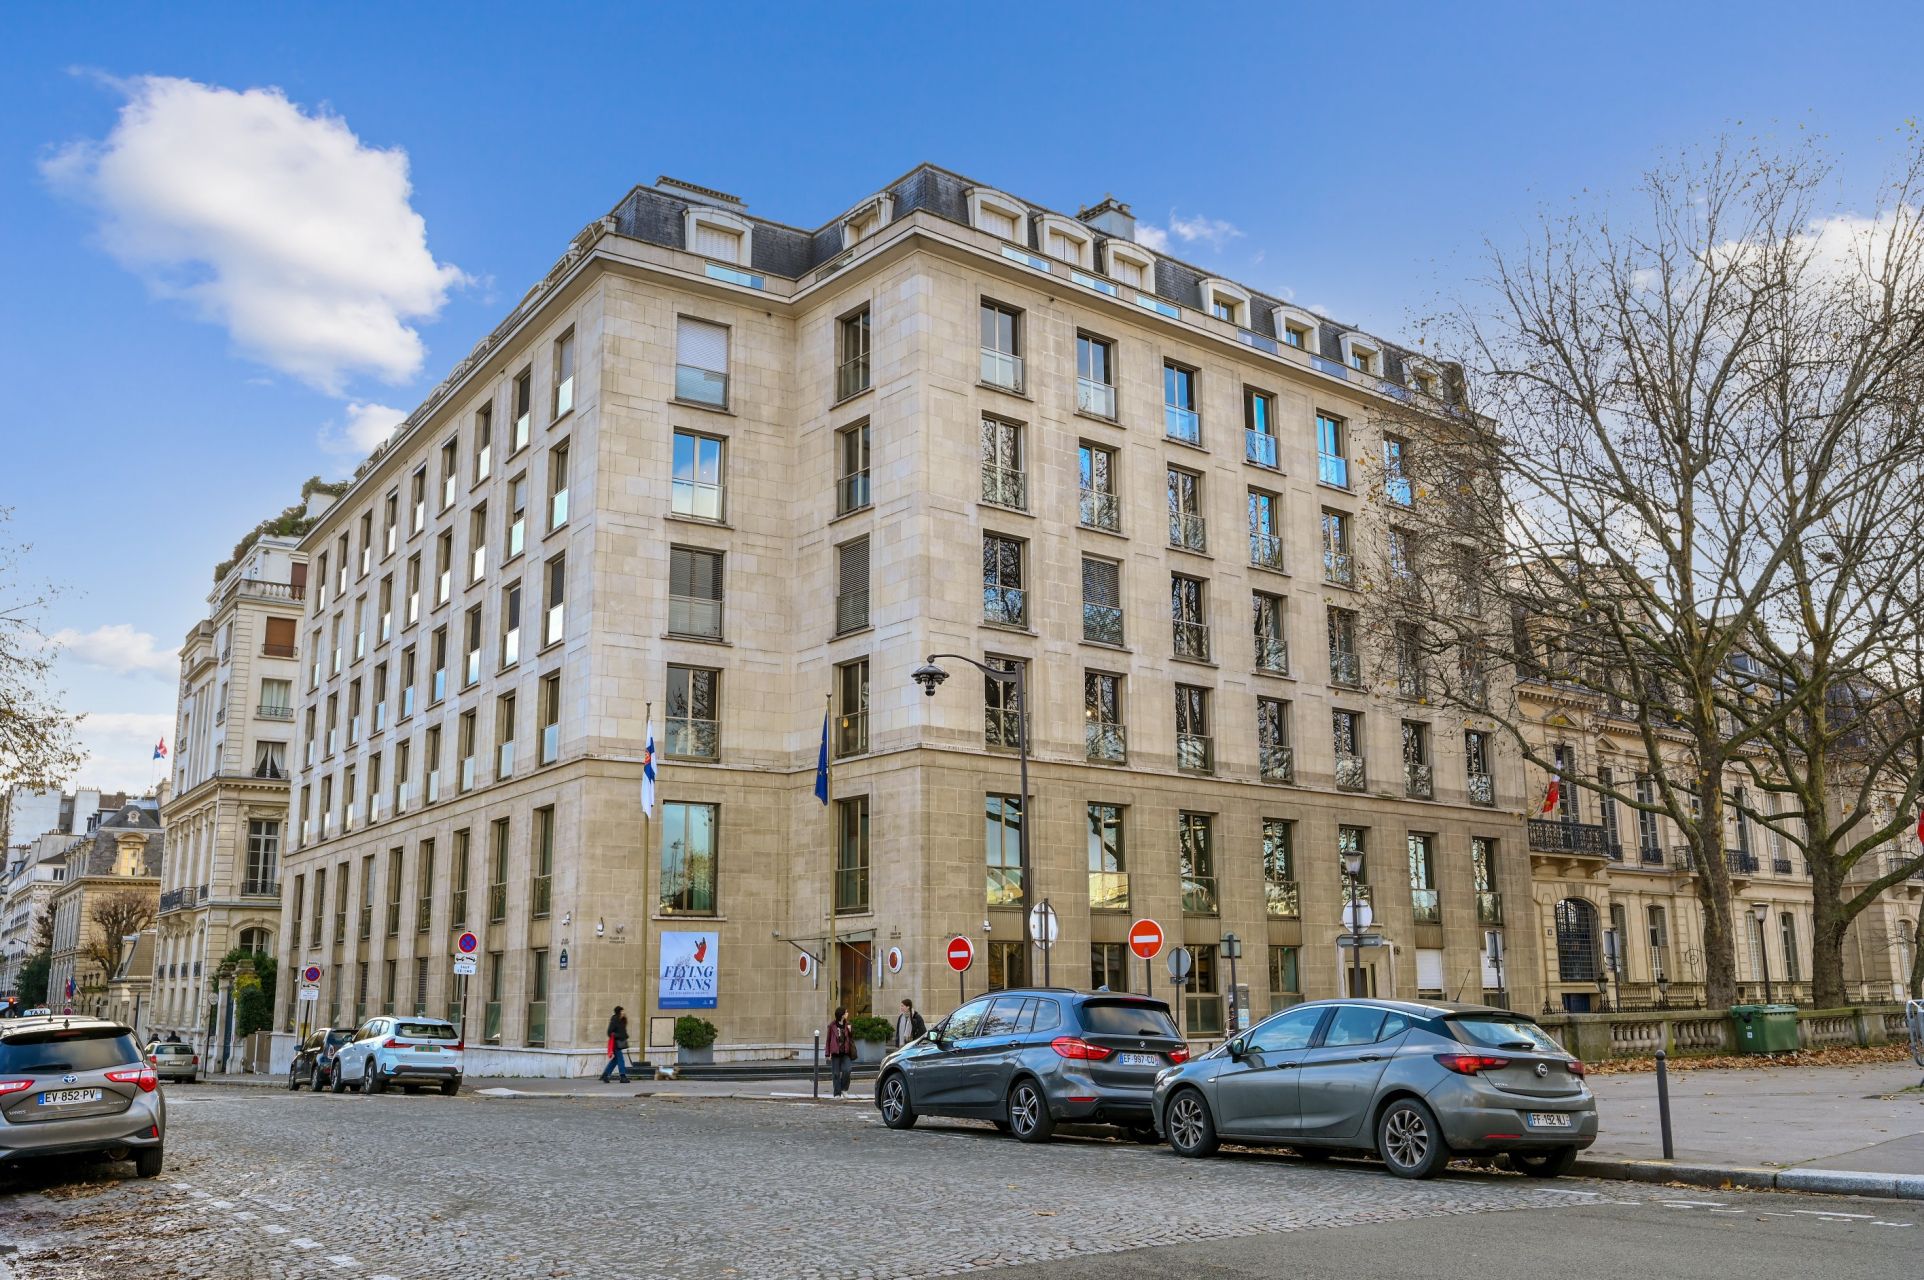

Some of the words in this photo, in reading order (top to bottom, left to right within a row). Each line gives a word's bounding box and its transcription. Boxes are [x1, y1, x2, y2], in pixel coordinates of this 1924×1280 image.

[664, 965, 714, 978] FLYING
[669, 978, 711, 991] FINNS
[45, 1089, 96, 1103] EV-852-PV
